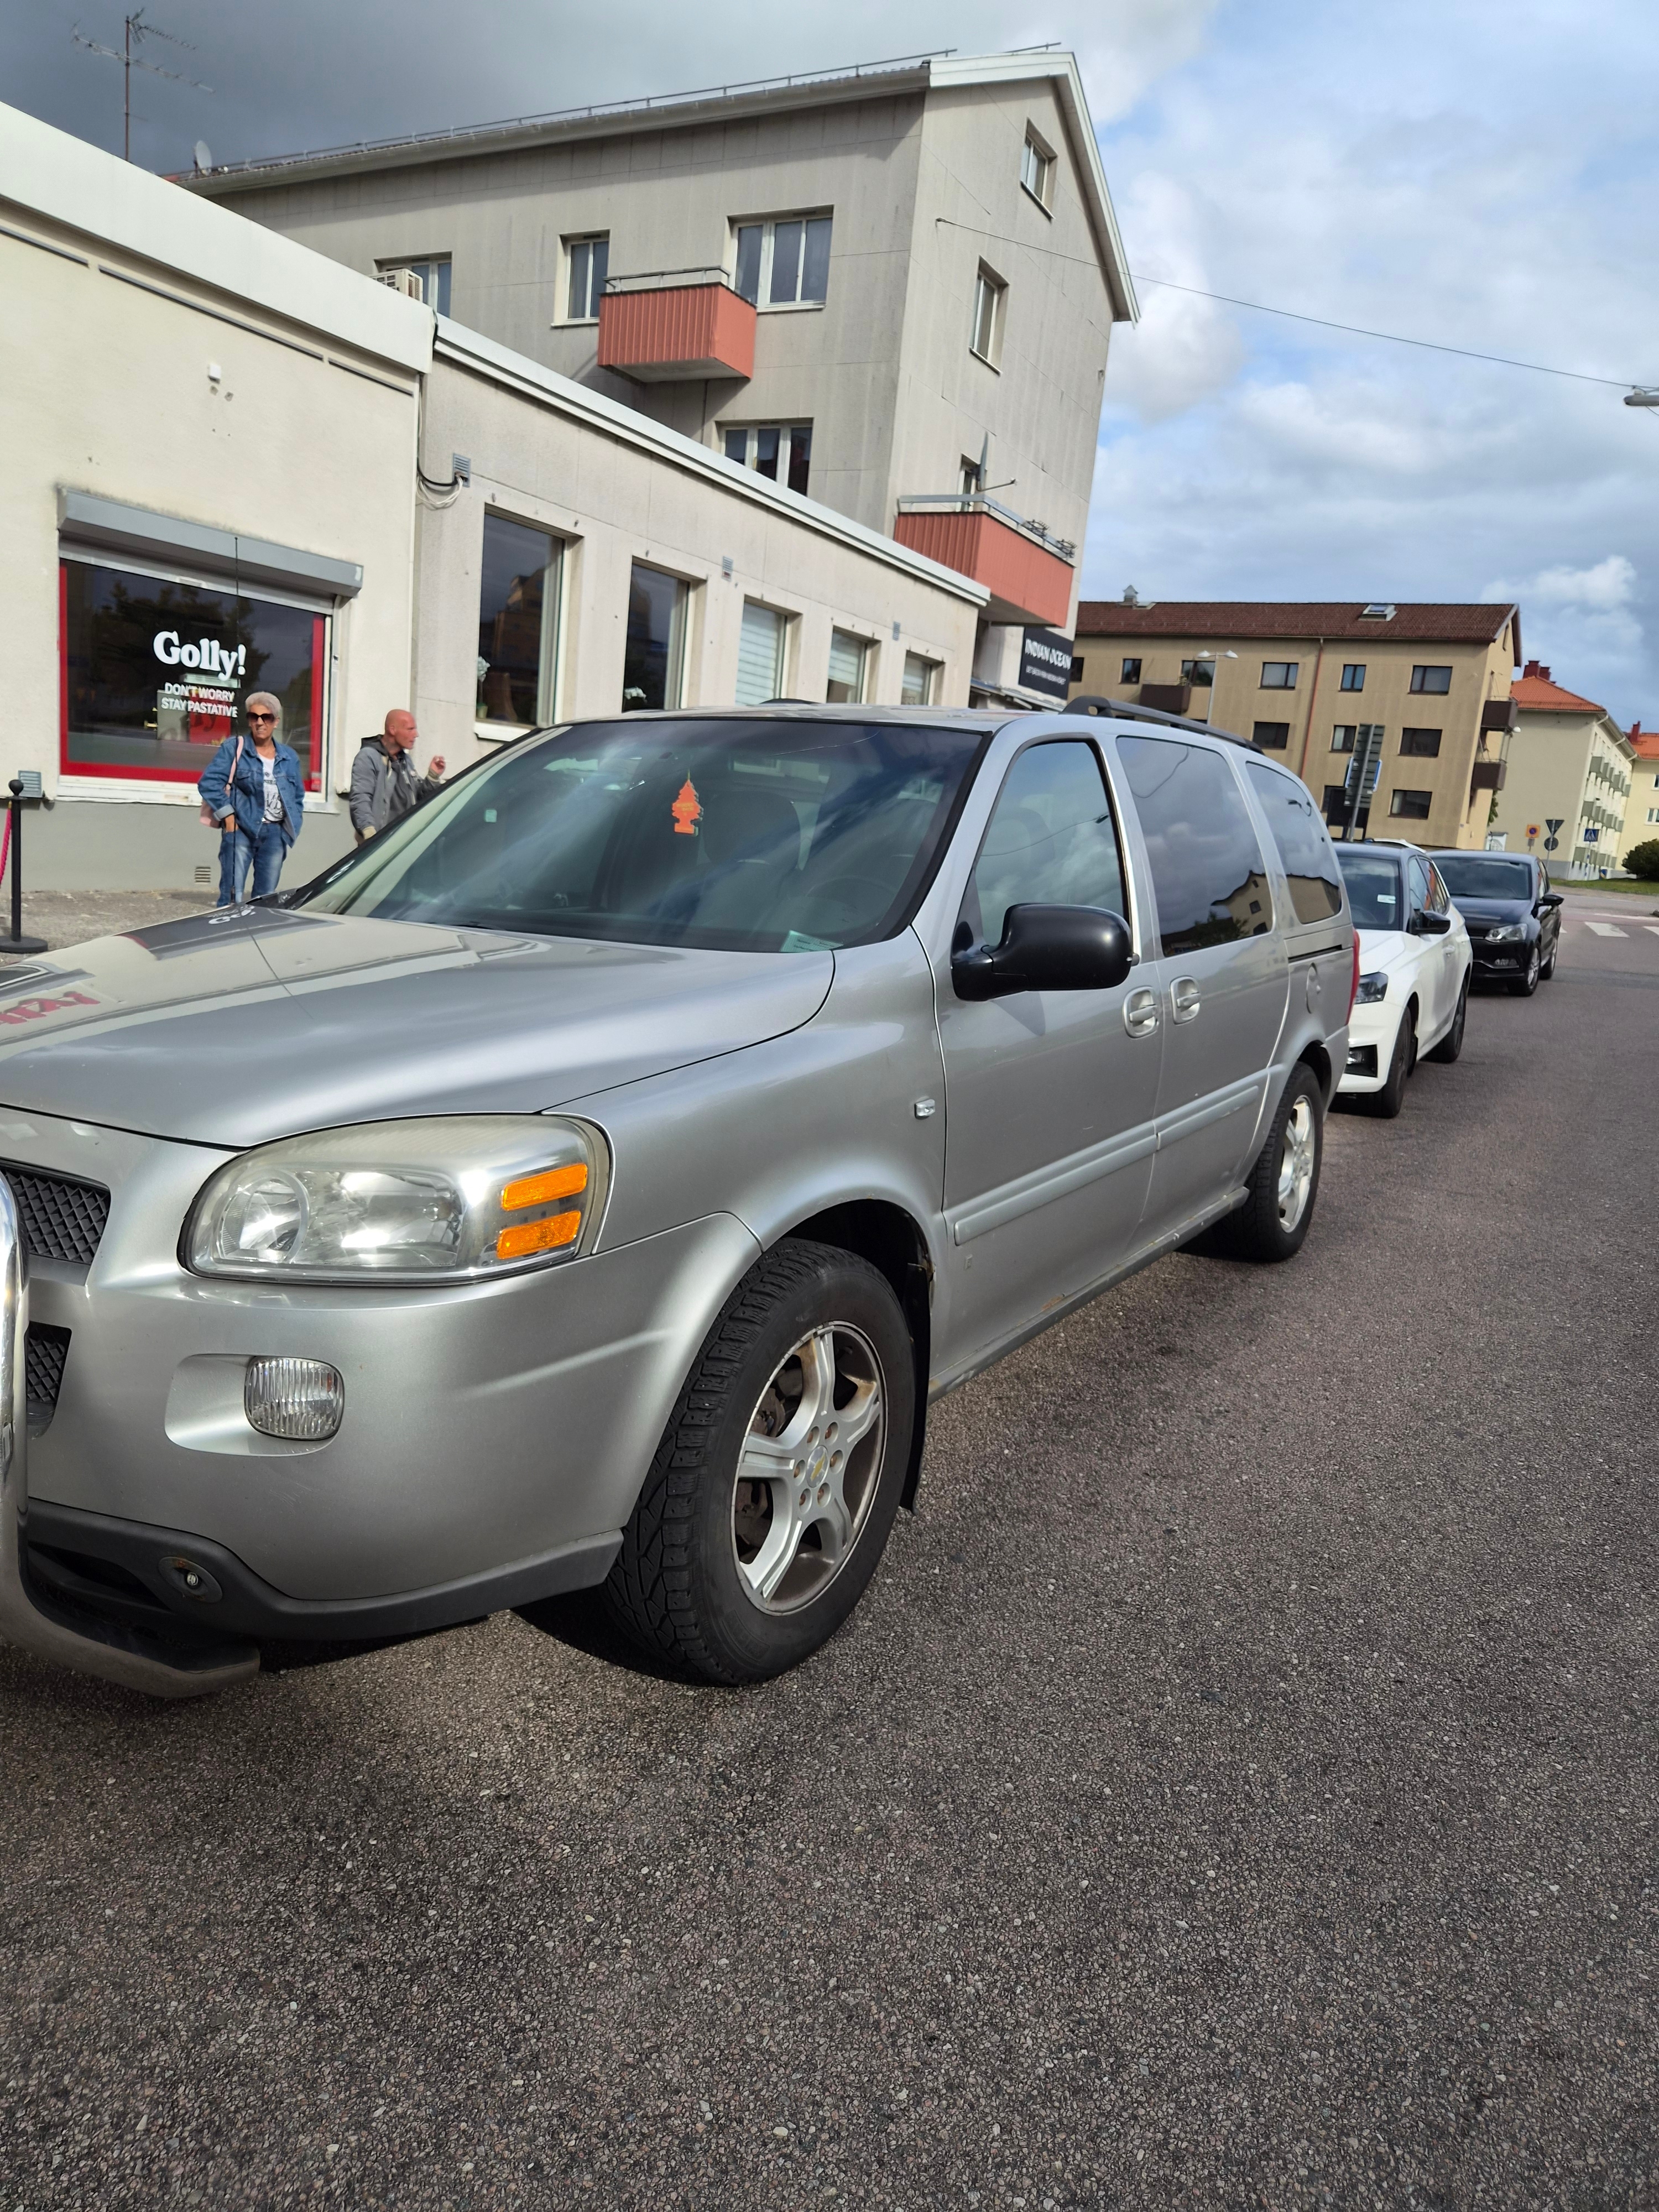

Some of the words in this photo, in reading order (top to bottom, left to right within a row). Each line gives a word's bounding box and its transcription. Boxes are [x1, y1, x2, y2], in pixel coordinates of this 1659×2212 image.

[153, 630, 247, 681] Golly!
[164, 682, 198, 697] DON'T
[199, 686, 235, 702] WORRY
[161, 697, 187, 711] STAY
[187, 700, 238, 718] PASTATIVE
